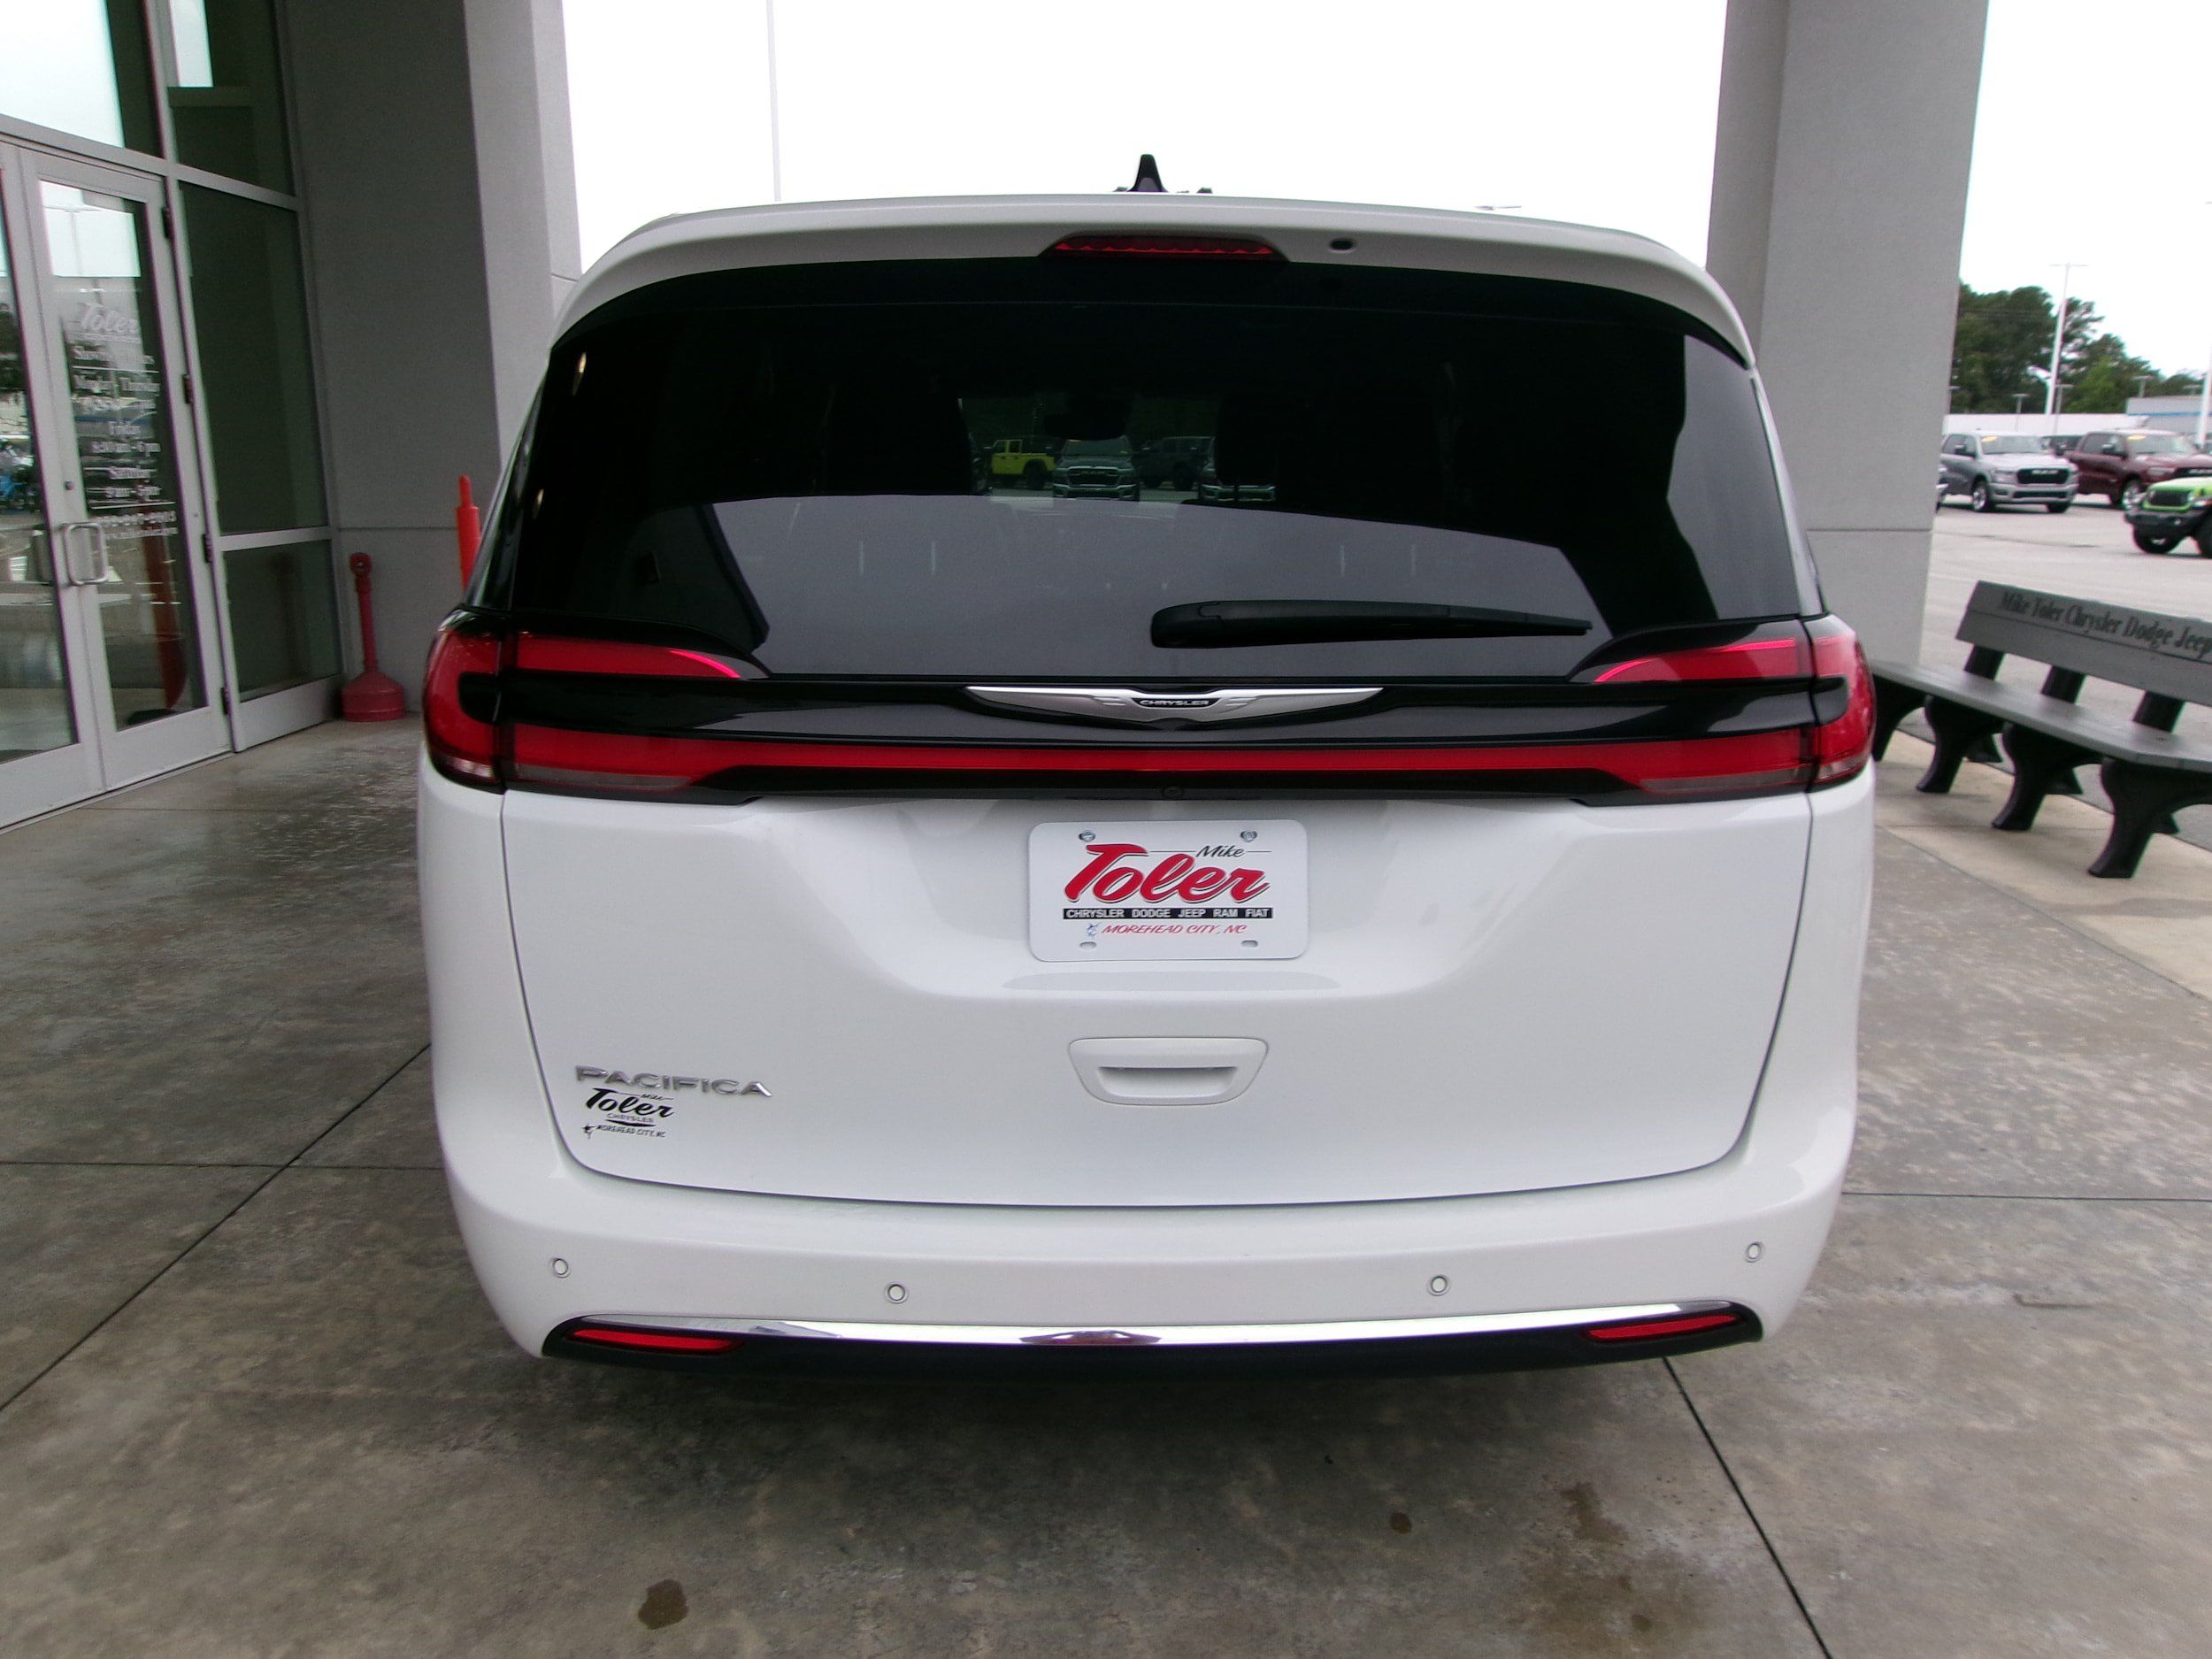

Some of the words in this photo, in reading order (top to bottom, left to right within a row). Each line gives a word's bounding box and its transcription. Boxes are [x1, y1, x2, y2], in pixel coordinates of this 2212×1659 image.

[2123, 616, 2173, 649] Dodge
[1195, 844, 1245, 858] Mike
[1064, 843, 1271, 903] Toler
[1065, 909, 1125, 919] CHRYSLER
[1132, 909, 1171, 918] DODGE
[1178, 908, 1206, 918] JEEP
[1213, 908, 1239, 918] RAM
[1245, 908, 1270, 918] FIAT
[1101, 925, 1183, 934] MOREHEAD
[1187, 925, 1221, 935] CITY,
[1225, 925, 1248, 934] NC
[575, 1064, 772, 1097] PACIFICA
[586, 1087, 674, 1118] Toler
[607, 1113, 654, 1123] CHRYSLER
[596, 1125, 636, 1134] MOREHEAD
